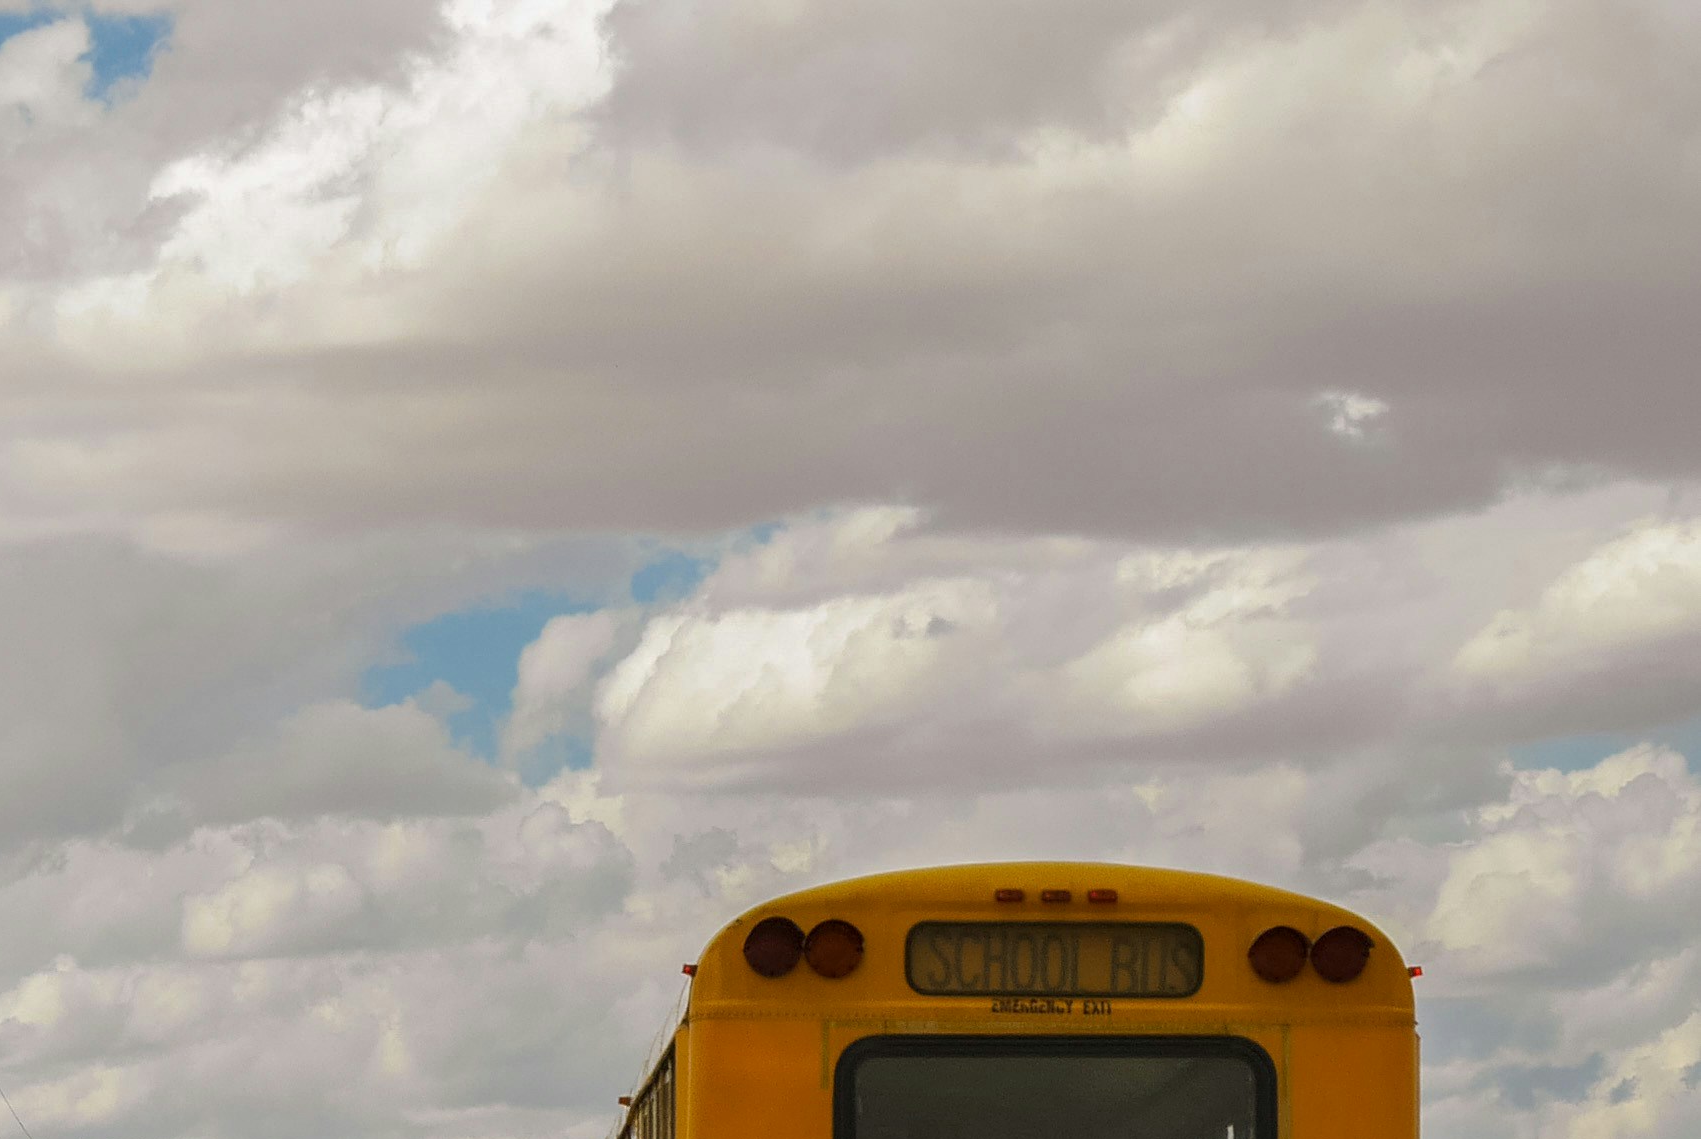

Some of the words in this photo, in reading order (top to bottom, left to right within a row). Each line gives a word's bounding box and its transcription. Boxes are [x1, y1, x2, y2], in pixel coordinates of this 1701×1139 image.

[926, 930, 1079, 991] SCHOOL
[1109, 931, 1195, 993] BUS
[991, 1000, 1073, 1015] EMERGENCY
[1083, 1000, 1112, 1015] EXIT
